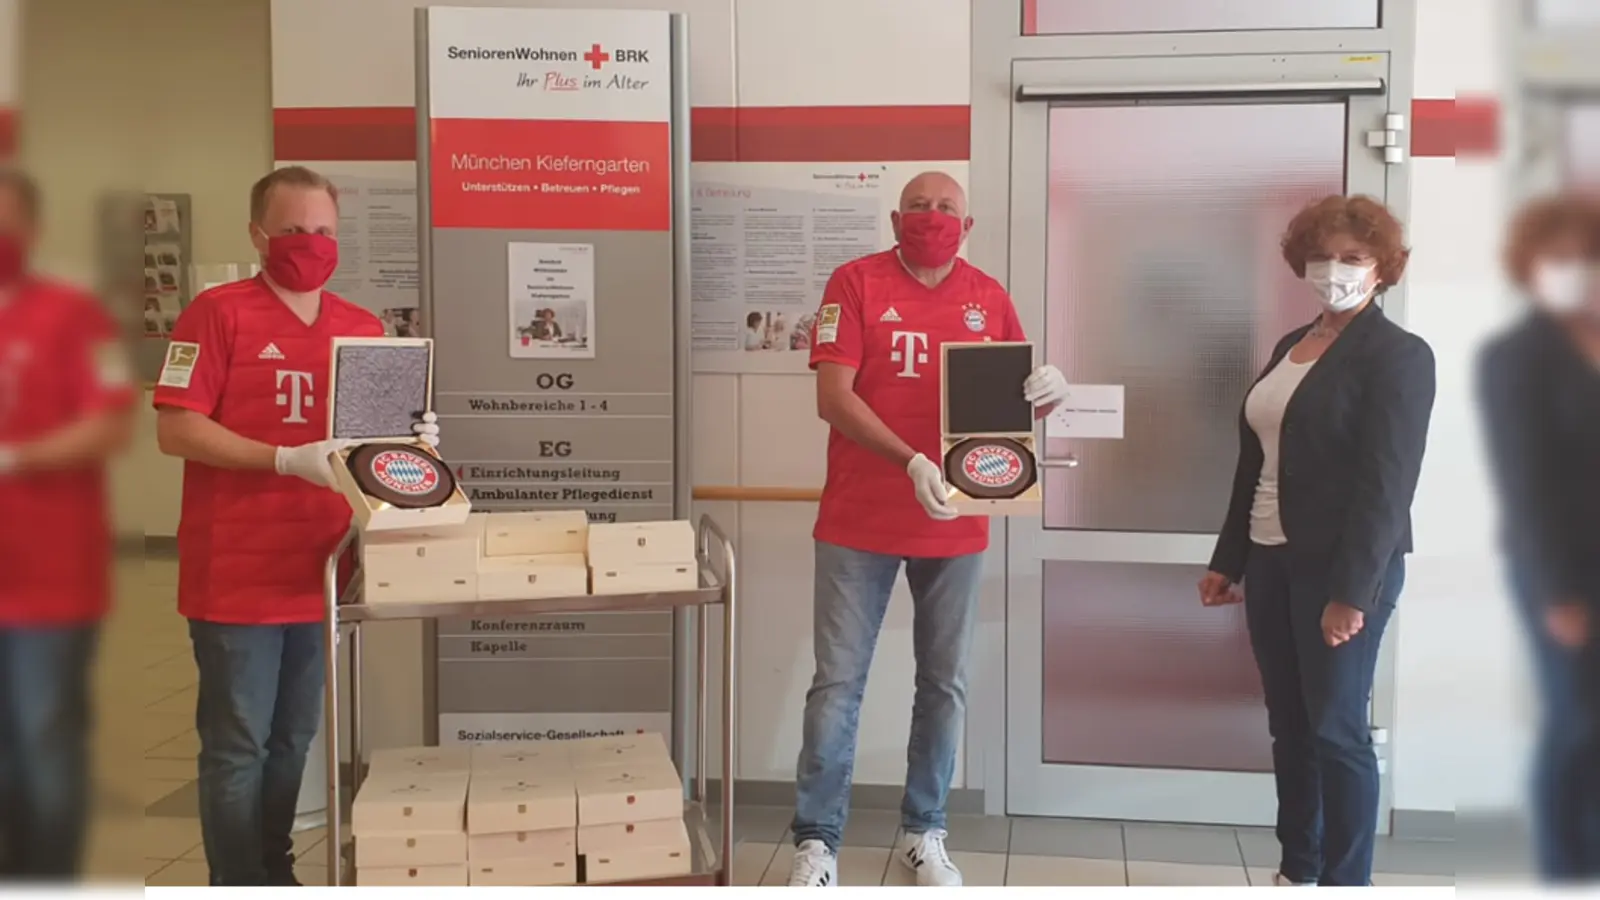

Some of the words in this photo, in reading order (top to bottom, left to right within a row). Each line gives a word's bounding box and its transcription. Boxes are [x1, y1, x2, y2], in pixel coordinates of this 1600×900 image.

[448, 46, 577, 62] SeniorenWohnen
[615, 49, 649, 63] BRK
[516, 72, 538, 88] Ihr
[544, 72, 579, 91] Plus
[583, 75, 602, 89] im
[606, 73, 649, 90] Alter
[451, 154, 532, 171] München
[536, 155, 650, 175] Kieferngarten
[462, 181, 531, 193] Unterstützen
[541, 183, 589, 194] Betreuen
[600, 183, 641, 196] Pflegen
[536, 373, 574, 390] OG
[469, 399, 576, 412] Wohnbereiche
[580, 400, 586, 411] 1
[600, 400, 608, 411] 4
[538, 441, 572, 457] EG
[470, 467, 620, 481] Einrichtungsleitung
[470, 489, 558, 500] Ambulanter
[562, 489, 653, 503] Pflegedienst
[470, 619, 586, 632] Konferenzraum
[470, 640, 528, 655] Kapelle
